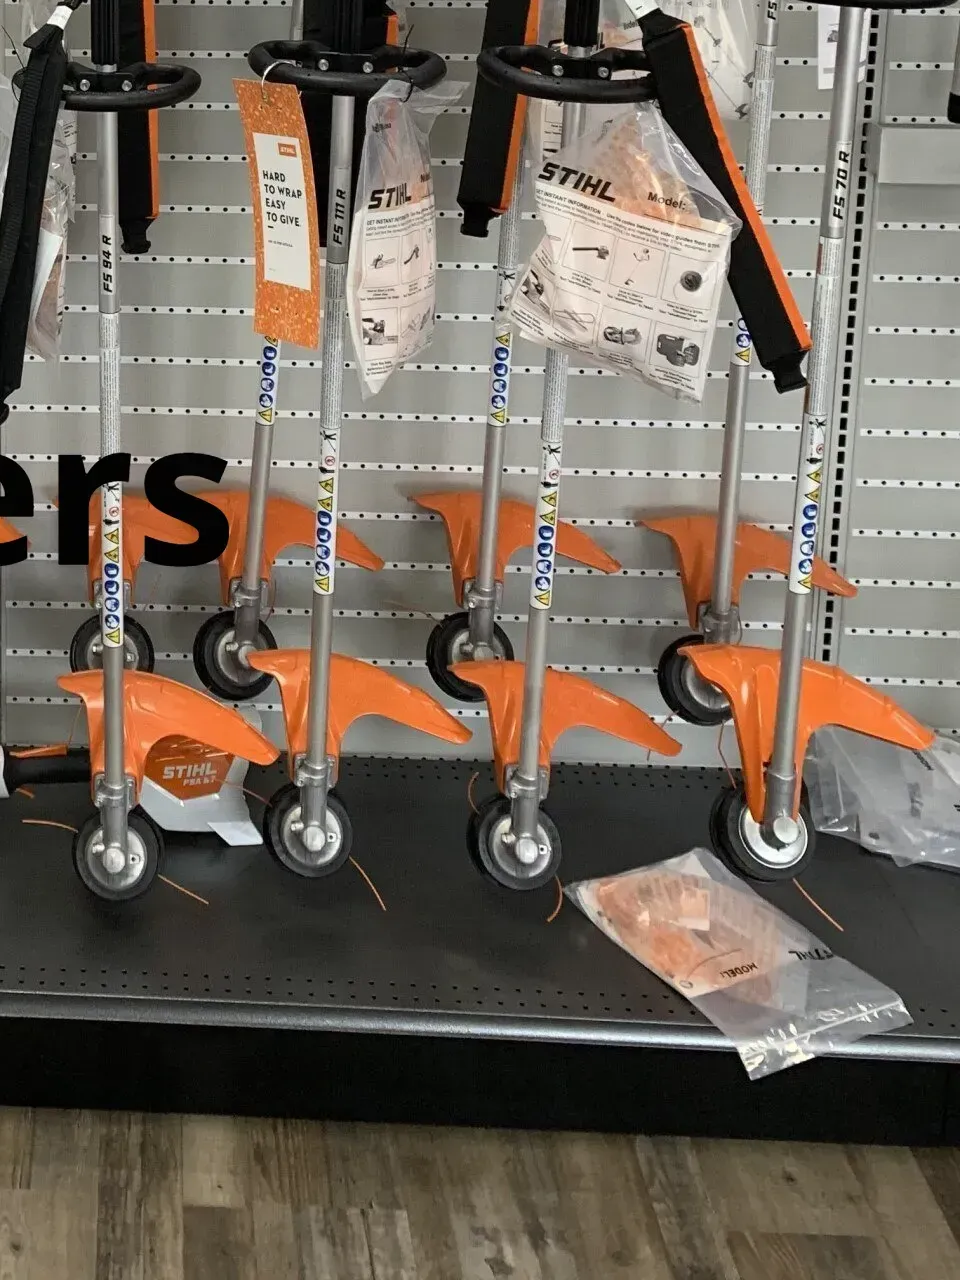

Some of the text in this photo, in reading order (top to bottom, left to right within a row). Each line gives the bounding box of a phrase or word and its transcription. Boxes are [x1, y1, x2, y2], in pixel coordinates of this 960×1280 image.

[767, 0, 778, 20] FS
[262, 170, 286, 183] HARD
[538, 162, 616, 203] STIHL
[832, 150, 850, 220] FS 70 R
[264, 184, 276, 195] TO
[368, 182, 412, 210] STIHL
[266, 198, 286, 211] EASY
[544, 191, 602, 215] INSTANT INFORMATION
[648, 192, 687, 211] Model:
[266, 211, 278, 222] TO
[333, 188, 347, 245] FS 111 R
[102, 235, 113, 293] FS 94 R
[162, 761, 217, 780] STIHL
